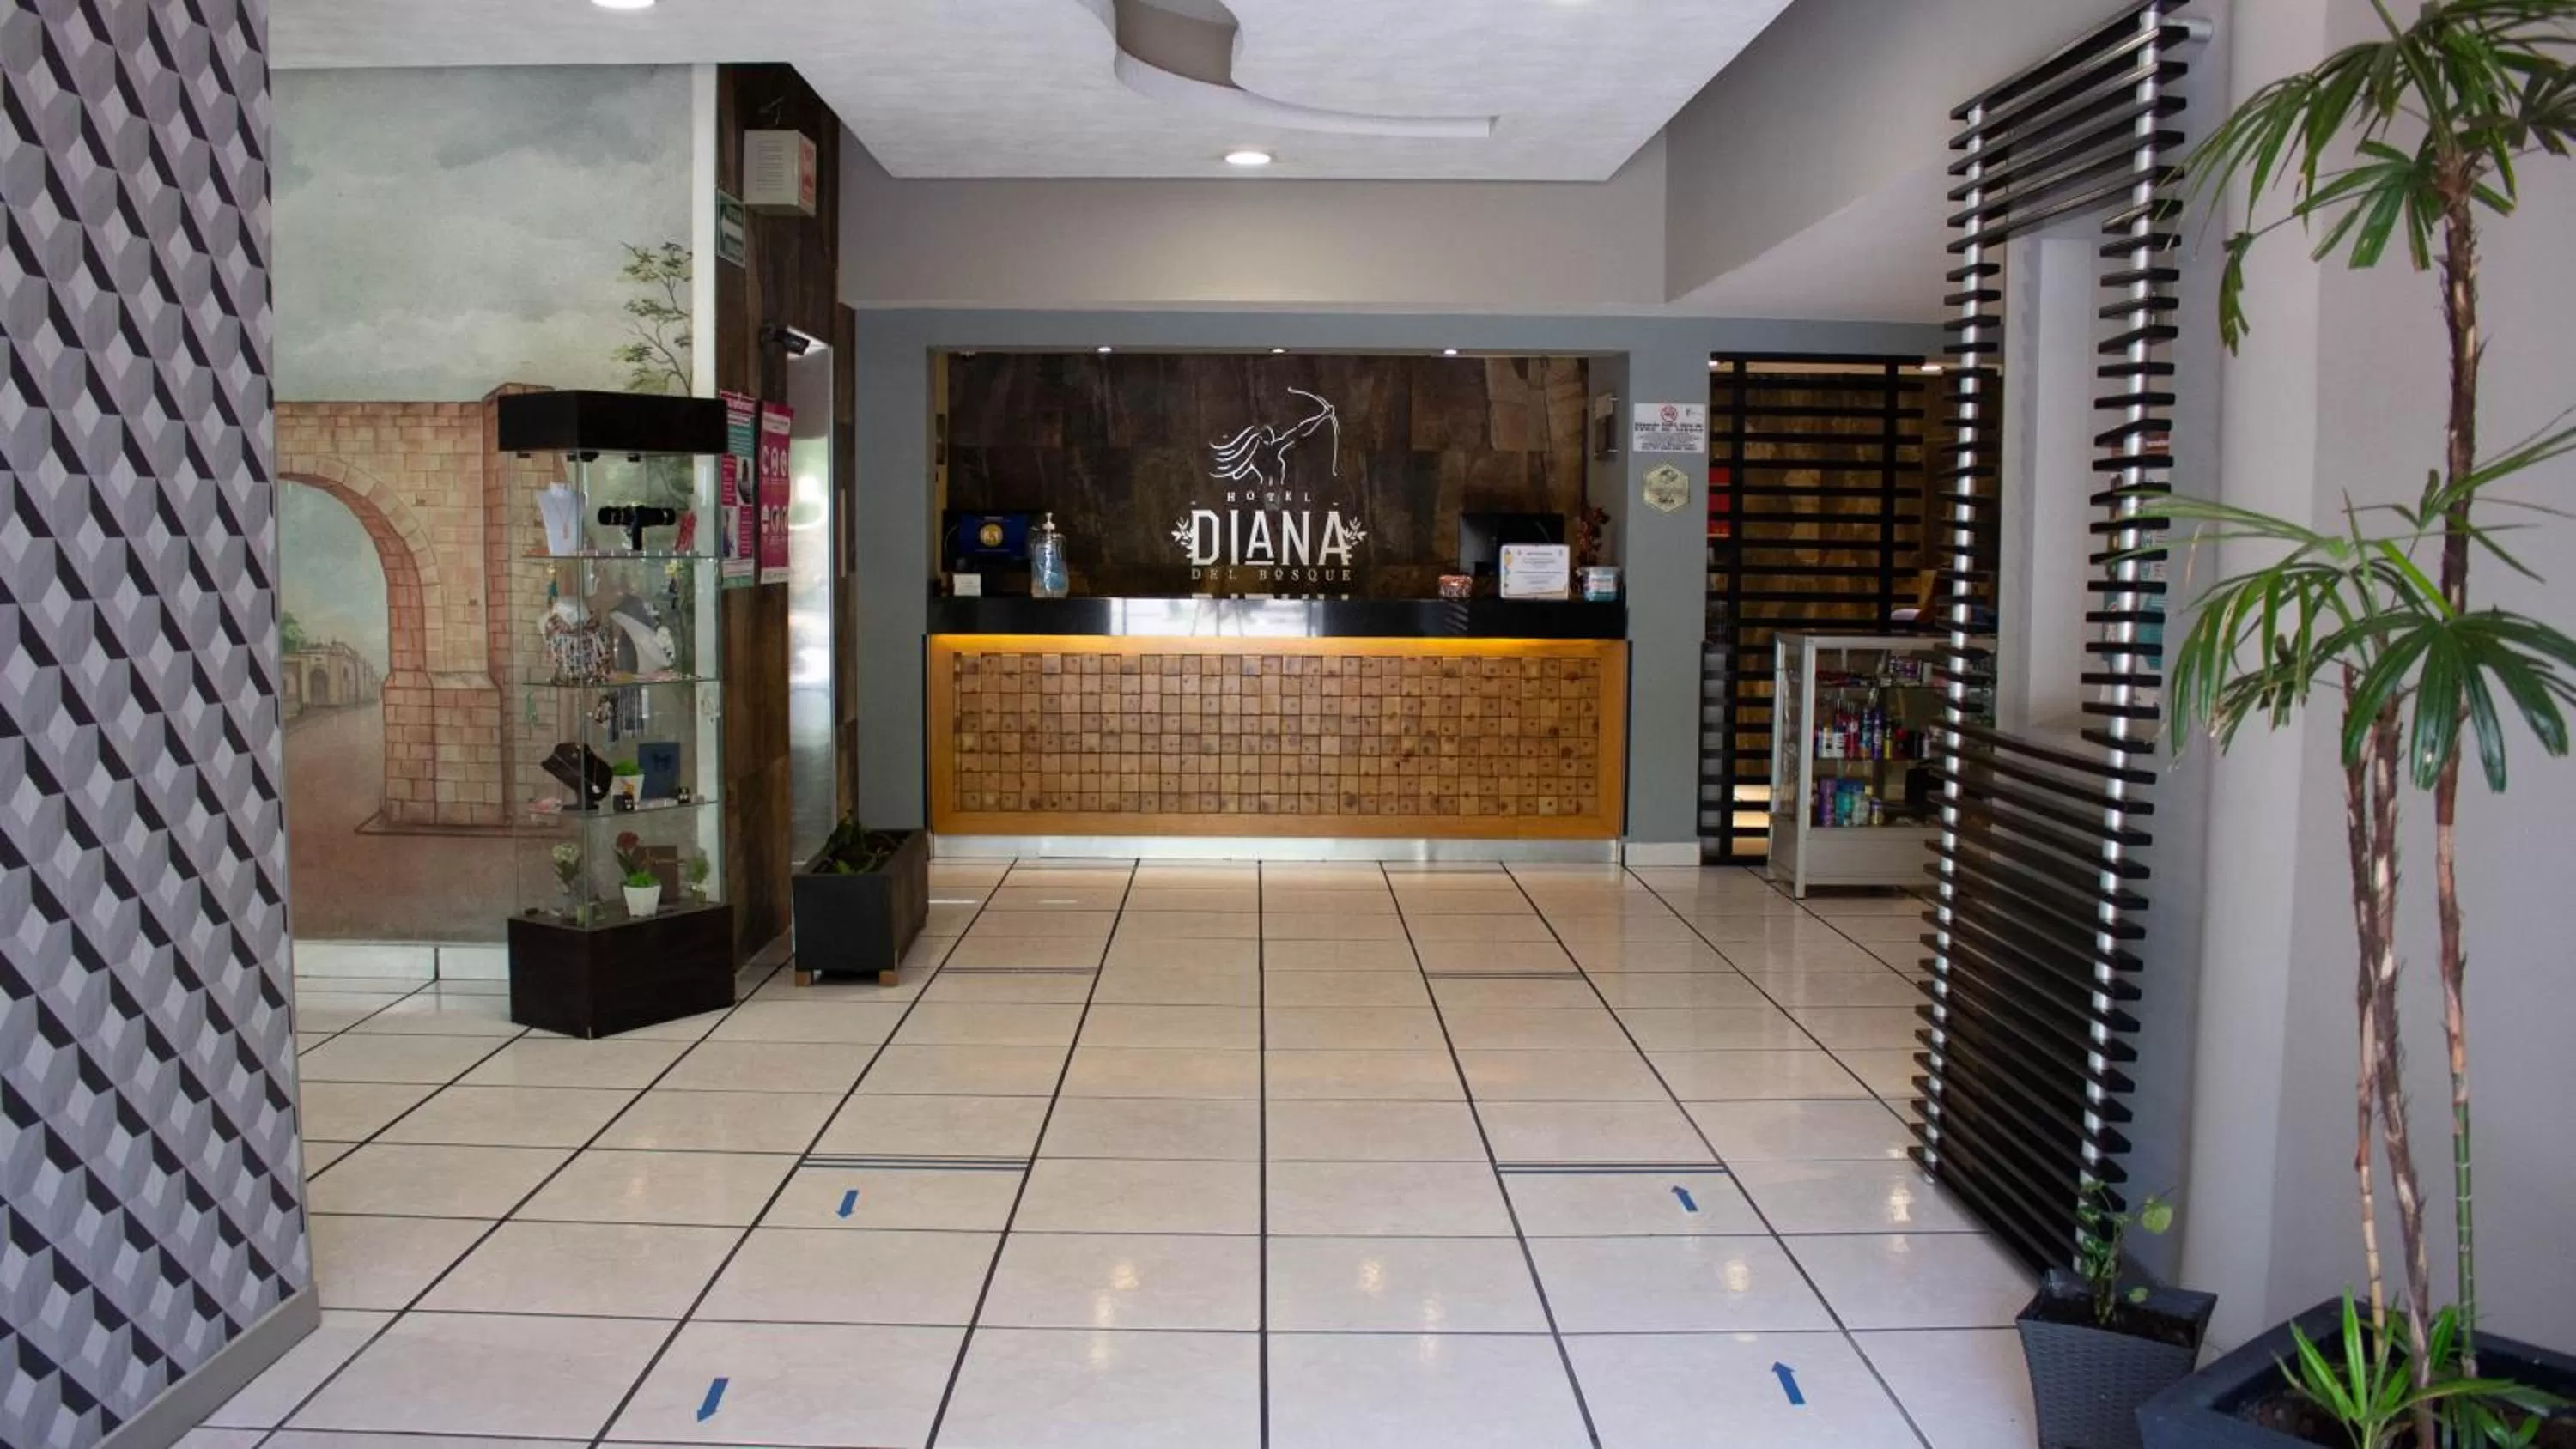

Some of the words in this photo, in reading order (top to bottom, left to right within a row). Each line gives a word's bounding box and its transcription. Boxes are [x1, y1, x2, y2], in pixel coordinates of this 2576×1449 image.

[1227, 491, 1311, 502] HOTEL
[1192, 509, 1351, 566] DIANA
[1192, 569, 1237, 580] DEL
[1259, 569, 1351, 581] BOSQUE
